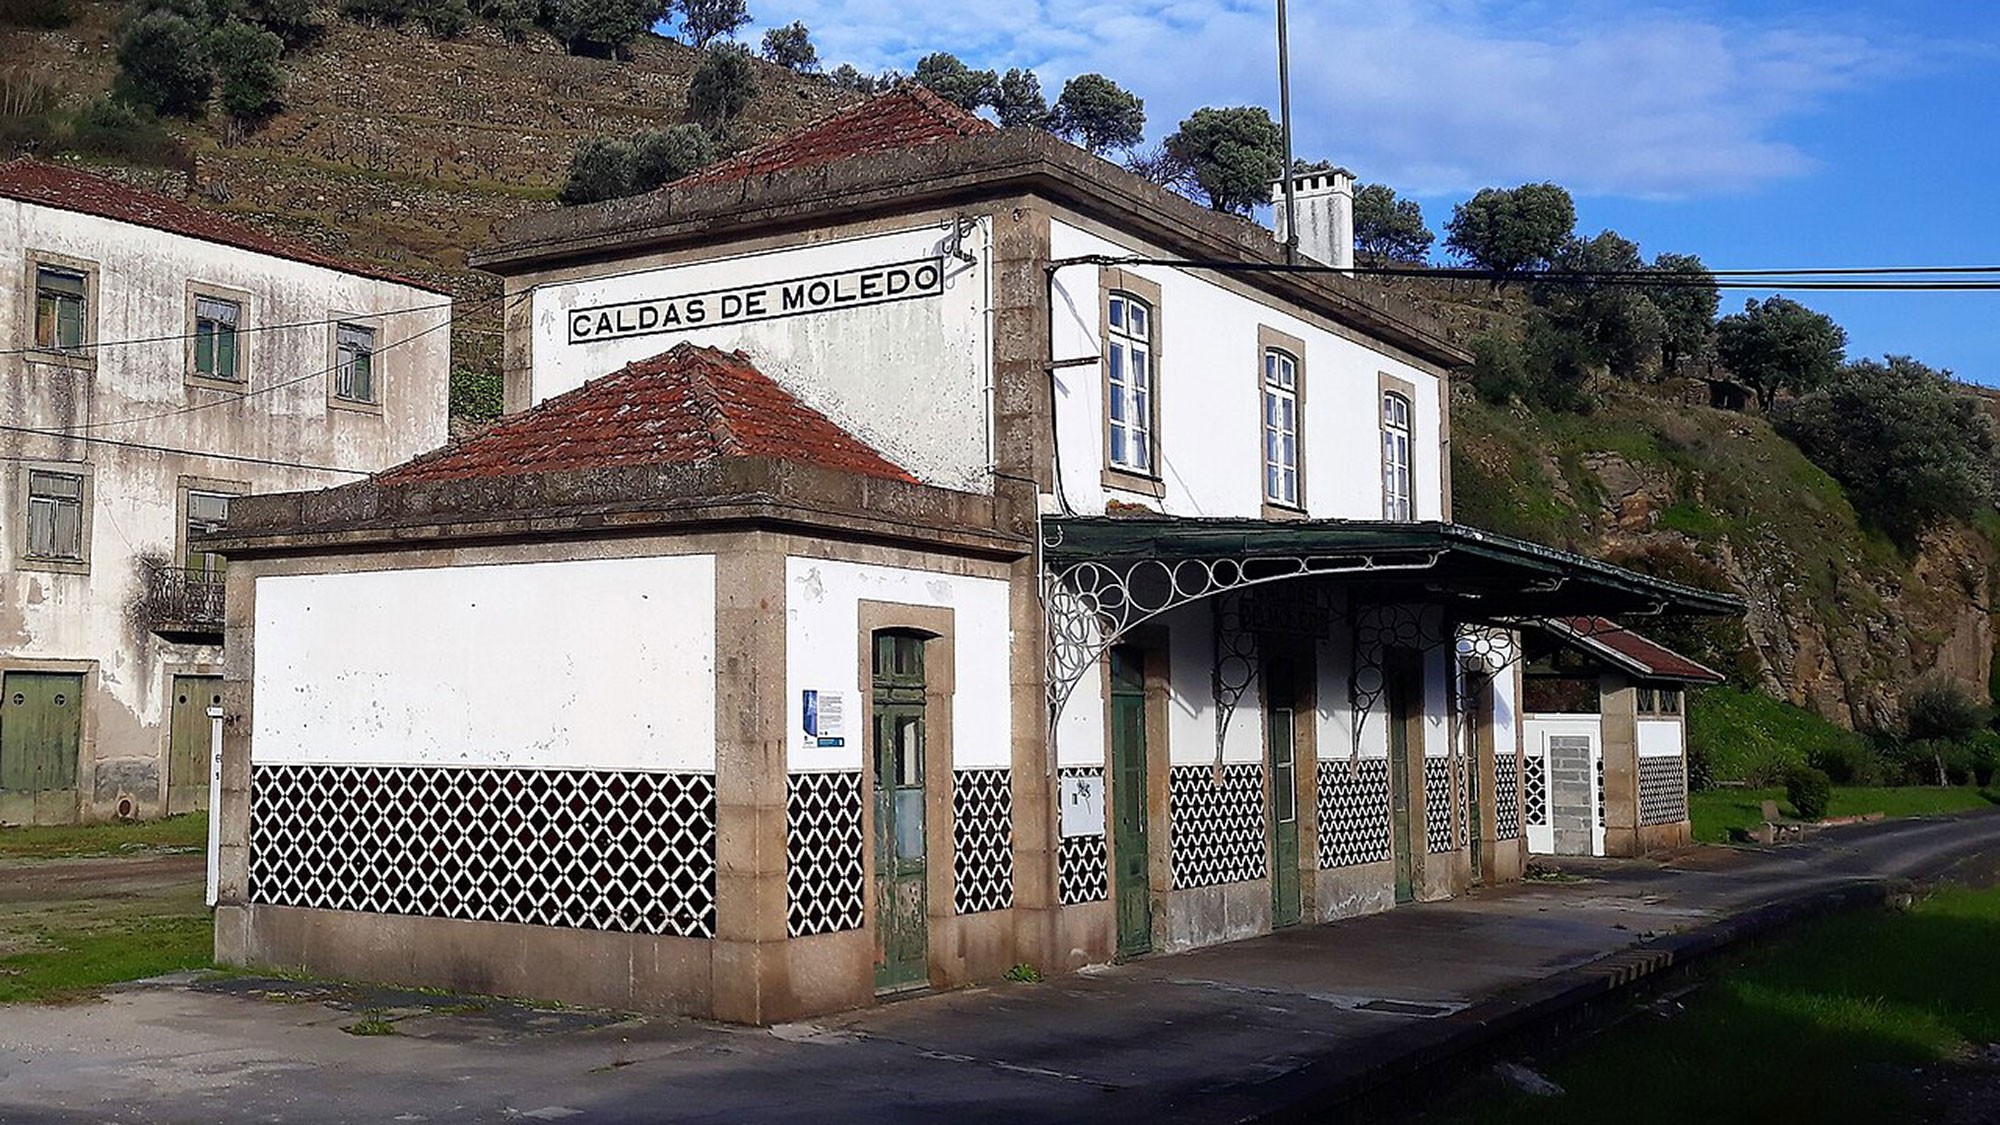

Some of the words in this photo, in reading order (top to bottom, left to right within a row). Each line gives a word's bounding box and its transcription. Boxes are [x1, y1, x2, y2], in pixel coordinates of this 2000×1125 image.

[573, 299, 706, 338] CALDAS
[721, 290, 767, 320] DE
[782, 265, 939, 311] MOLEDO
